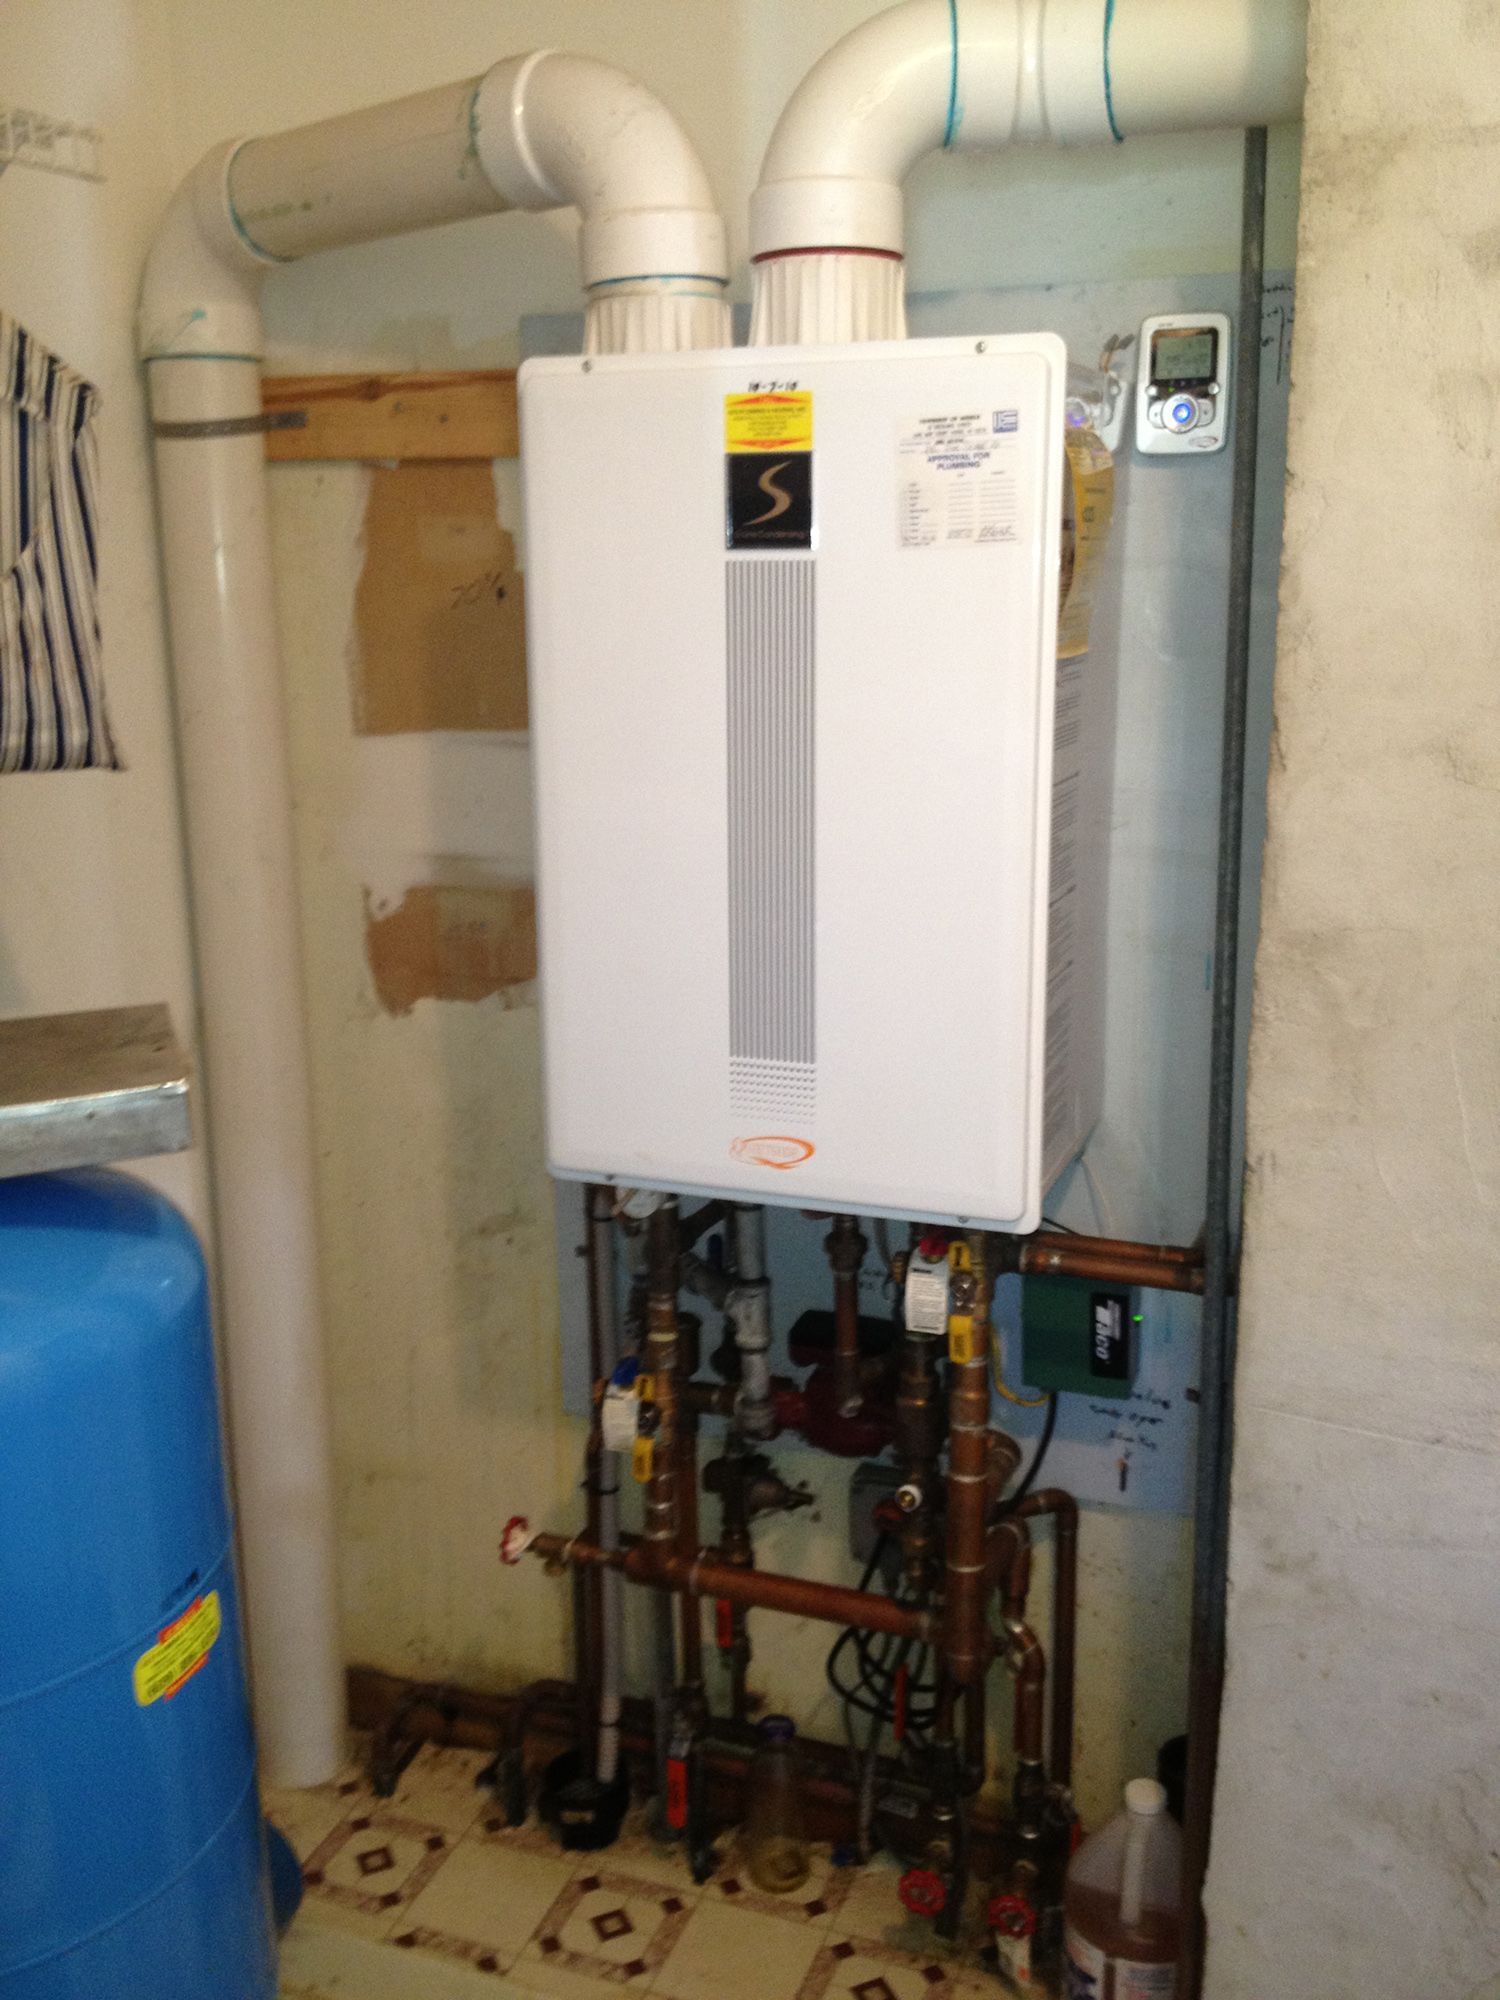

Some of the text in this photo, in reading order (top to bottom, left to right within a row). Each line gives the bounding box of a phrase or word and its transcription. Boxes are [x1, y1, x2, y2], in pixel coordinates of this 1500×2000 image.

[927, 452, 991, 463] APPROVAL FOR
[936, 461, 981, 471] PLUMBING
